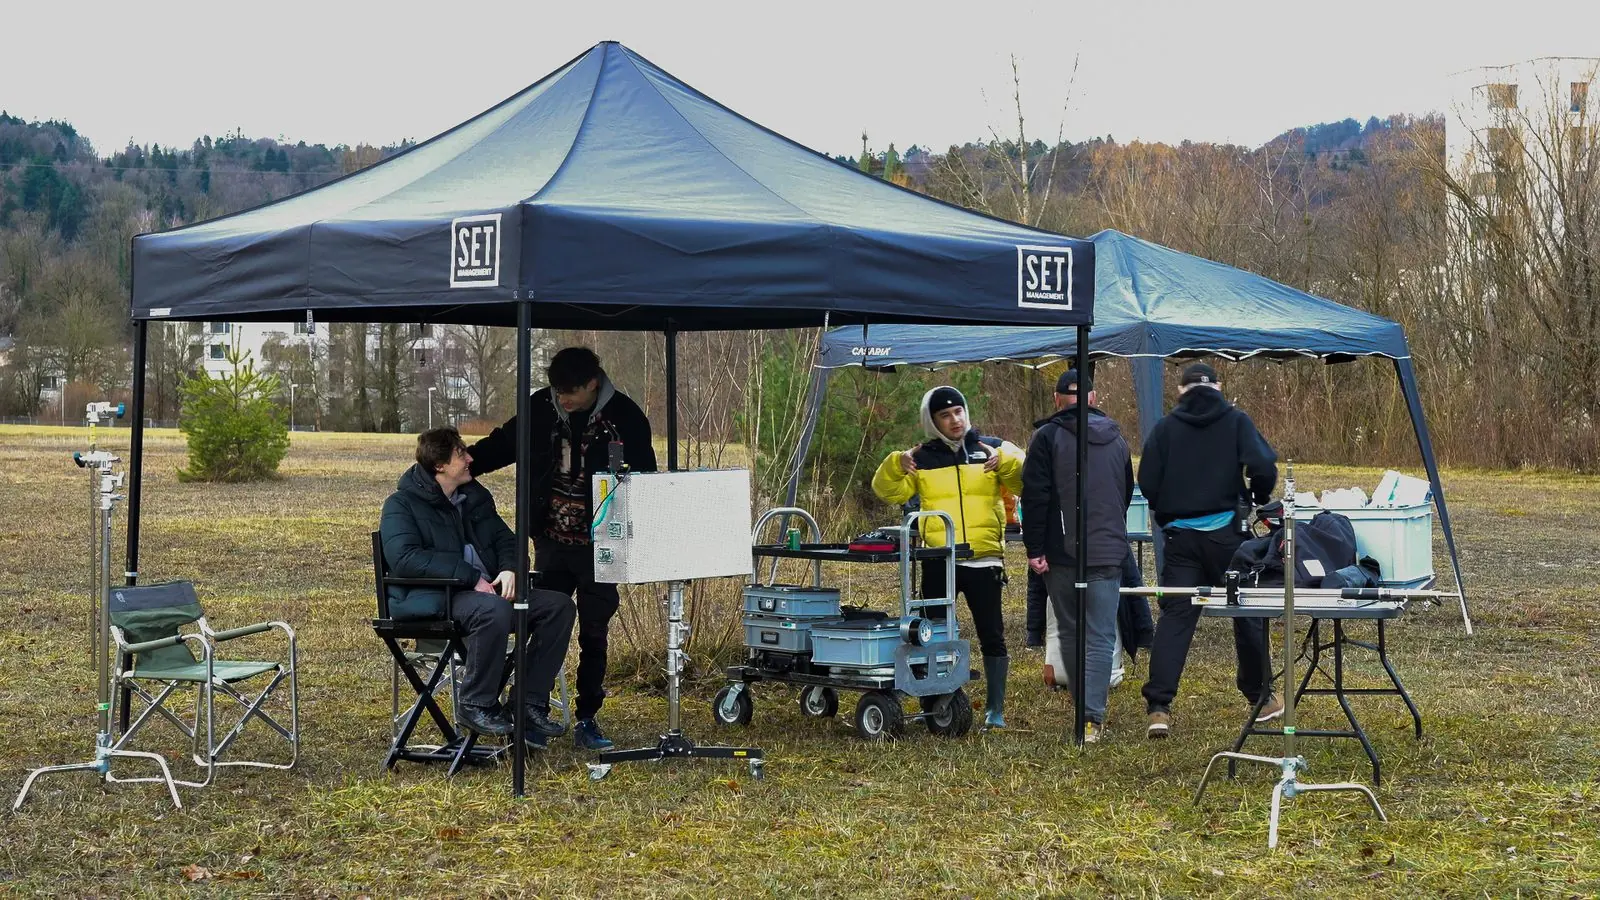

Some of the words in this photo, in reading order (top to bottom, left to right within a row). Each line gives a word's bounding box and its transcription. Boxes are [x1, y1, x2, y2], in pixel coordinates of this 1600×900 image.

[458, 225, 494, 267] SET
[1026, 254, 1065, 292] SET
[1026, 291, 1064, 300] MANAGEMENT
